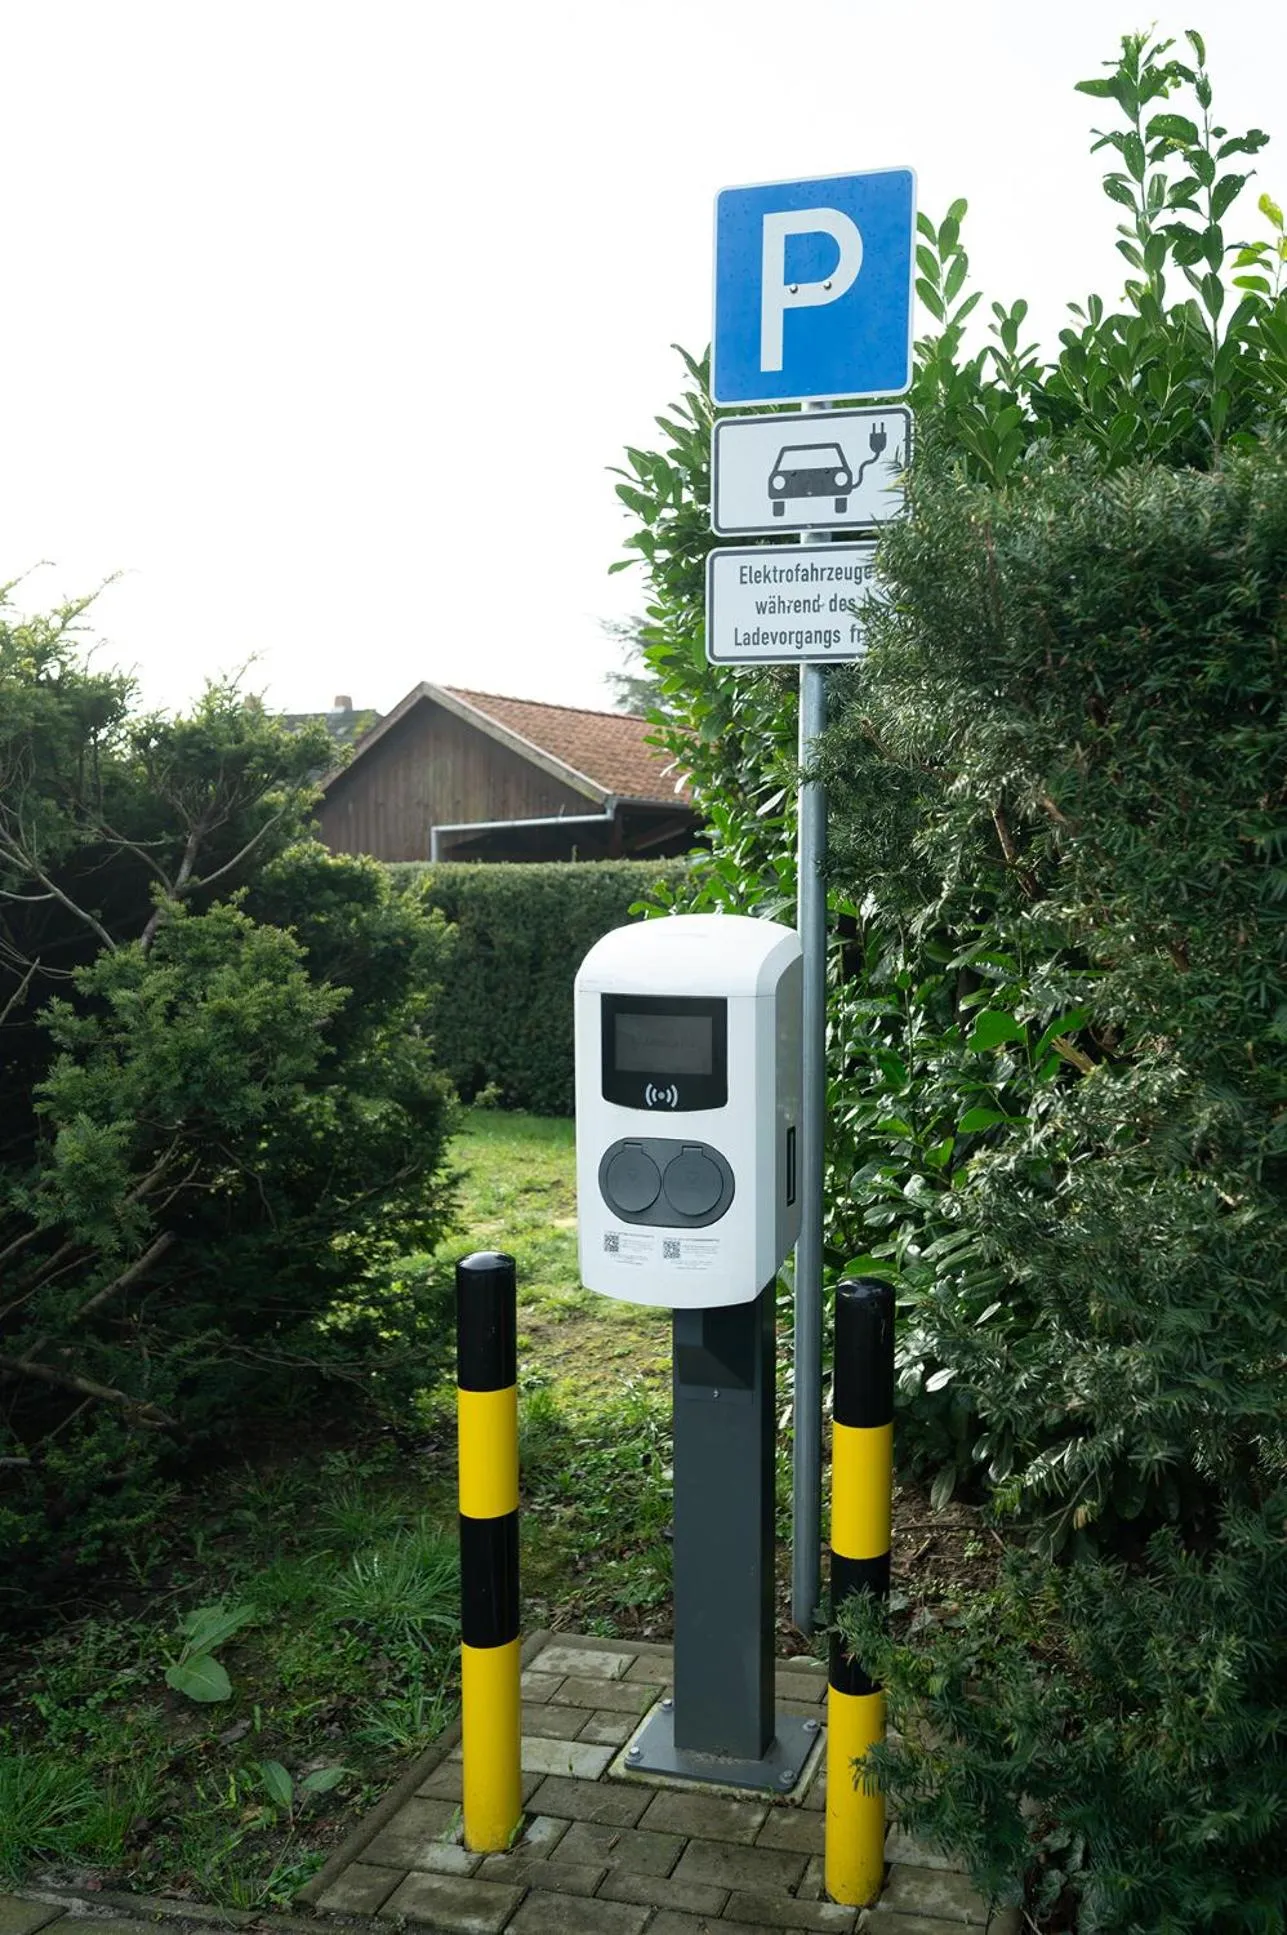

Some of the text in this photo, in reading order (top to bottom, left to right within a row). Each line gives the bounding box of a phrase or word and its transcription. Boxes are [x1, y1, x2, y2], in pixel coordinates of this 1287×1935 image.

[760, 207, 863, 372] P
[739, 562, 873, 585] Elektrofahrzeuge
[755, 593, 856, 615] während des
[734, 627, 841, 649] Ladevorgangs
